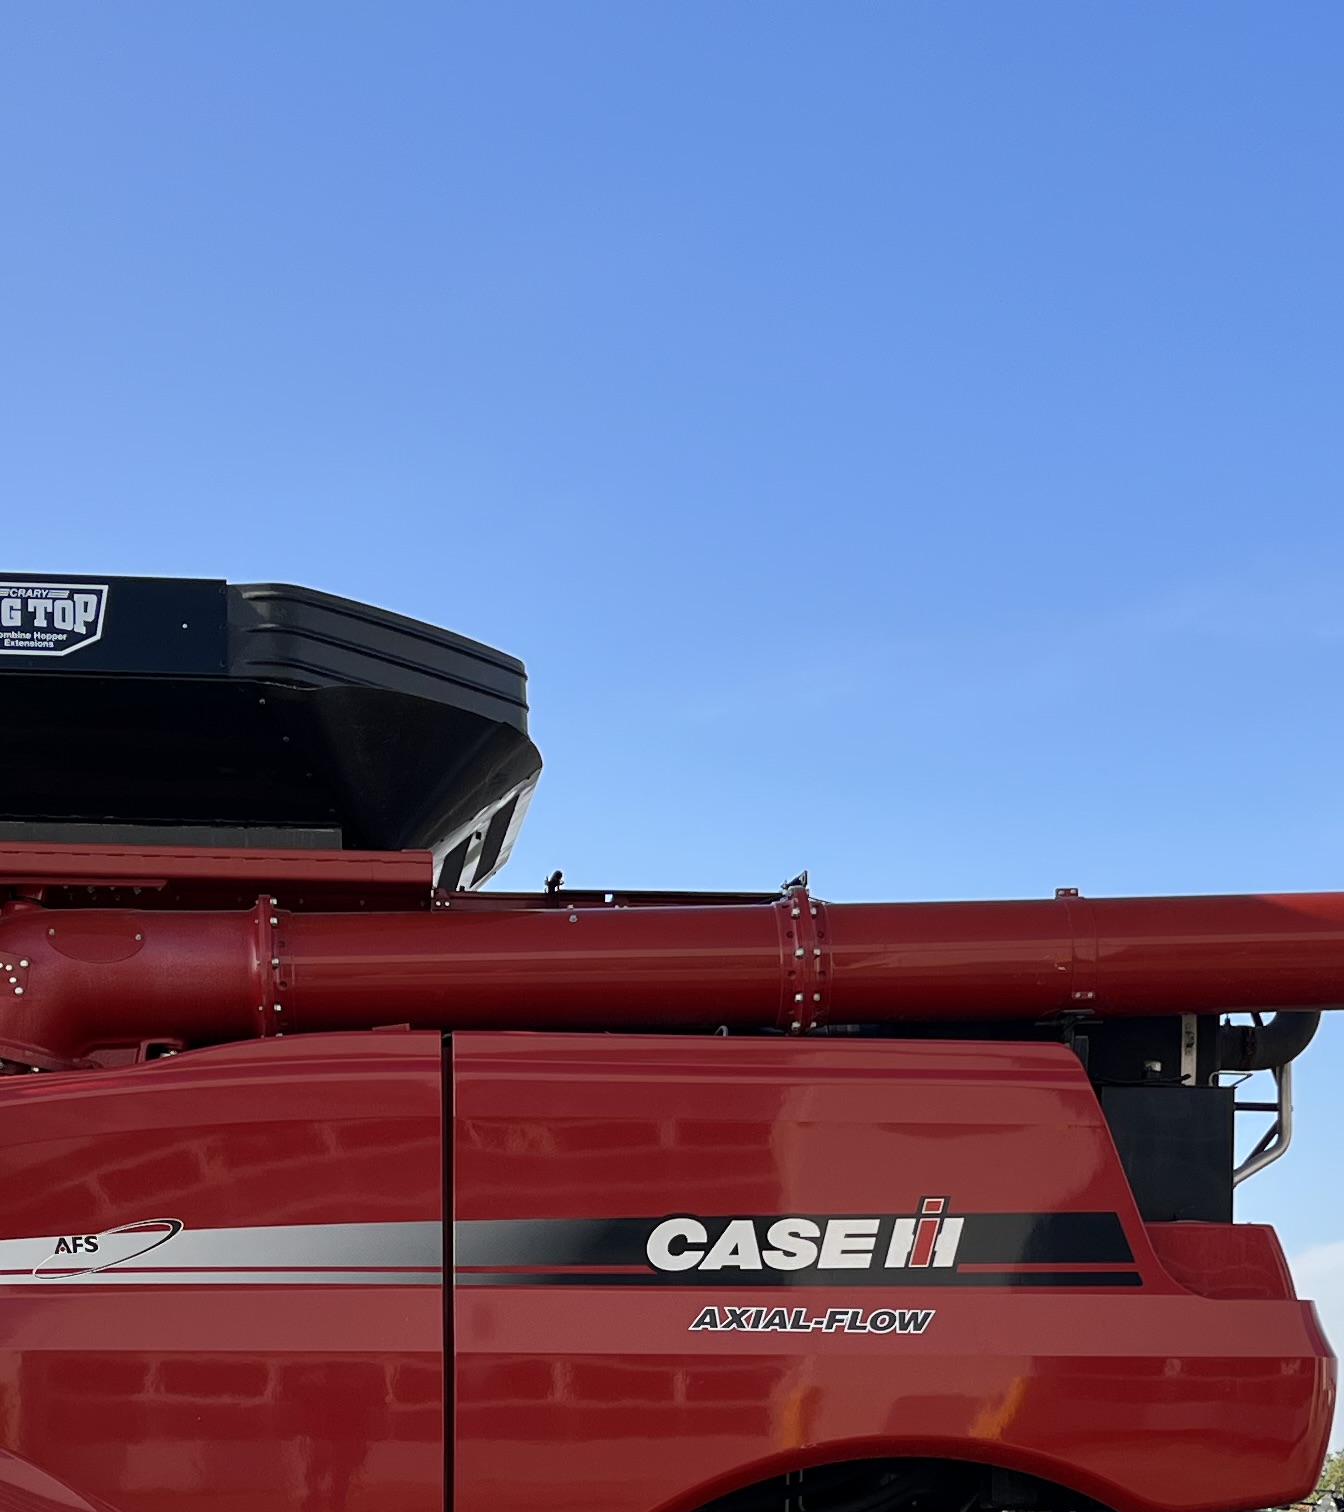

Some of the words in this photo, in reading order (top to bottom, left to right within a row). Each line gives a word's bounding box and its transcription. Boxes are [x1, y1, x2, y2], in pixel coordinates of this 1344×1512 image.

[9, 588, 49, 598] CRARY
[27, 593, 98, 634] TOP
[4, 639, 54, 648] Extensions
[33, 631, 68, 642] Hopper
[54, 1235, 99, 1255] AFS
[646, 1217, 881, 1271] CASE
[688, 1305, 937, 1334] AXIAL-FLOW
